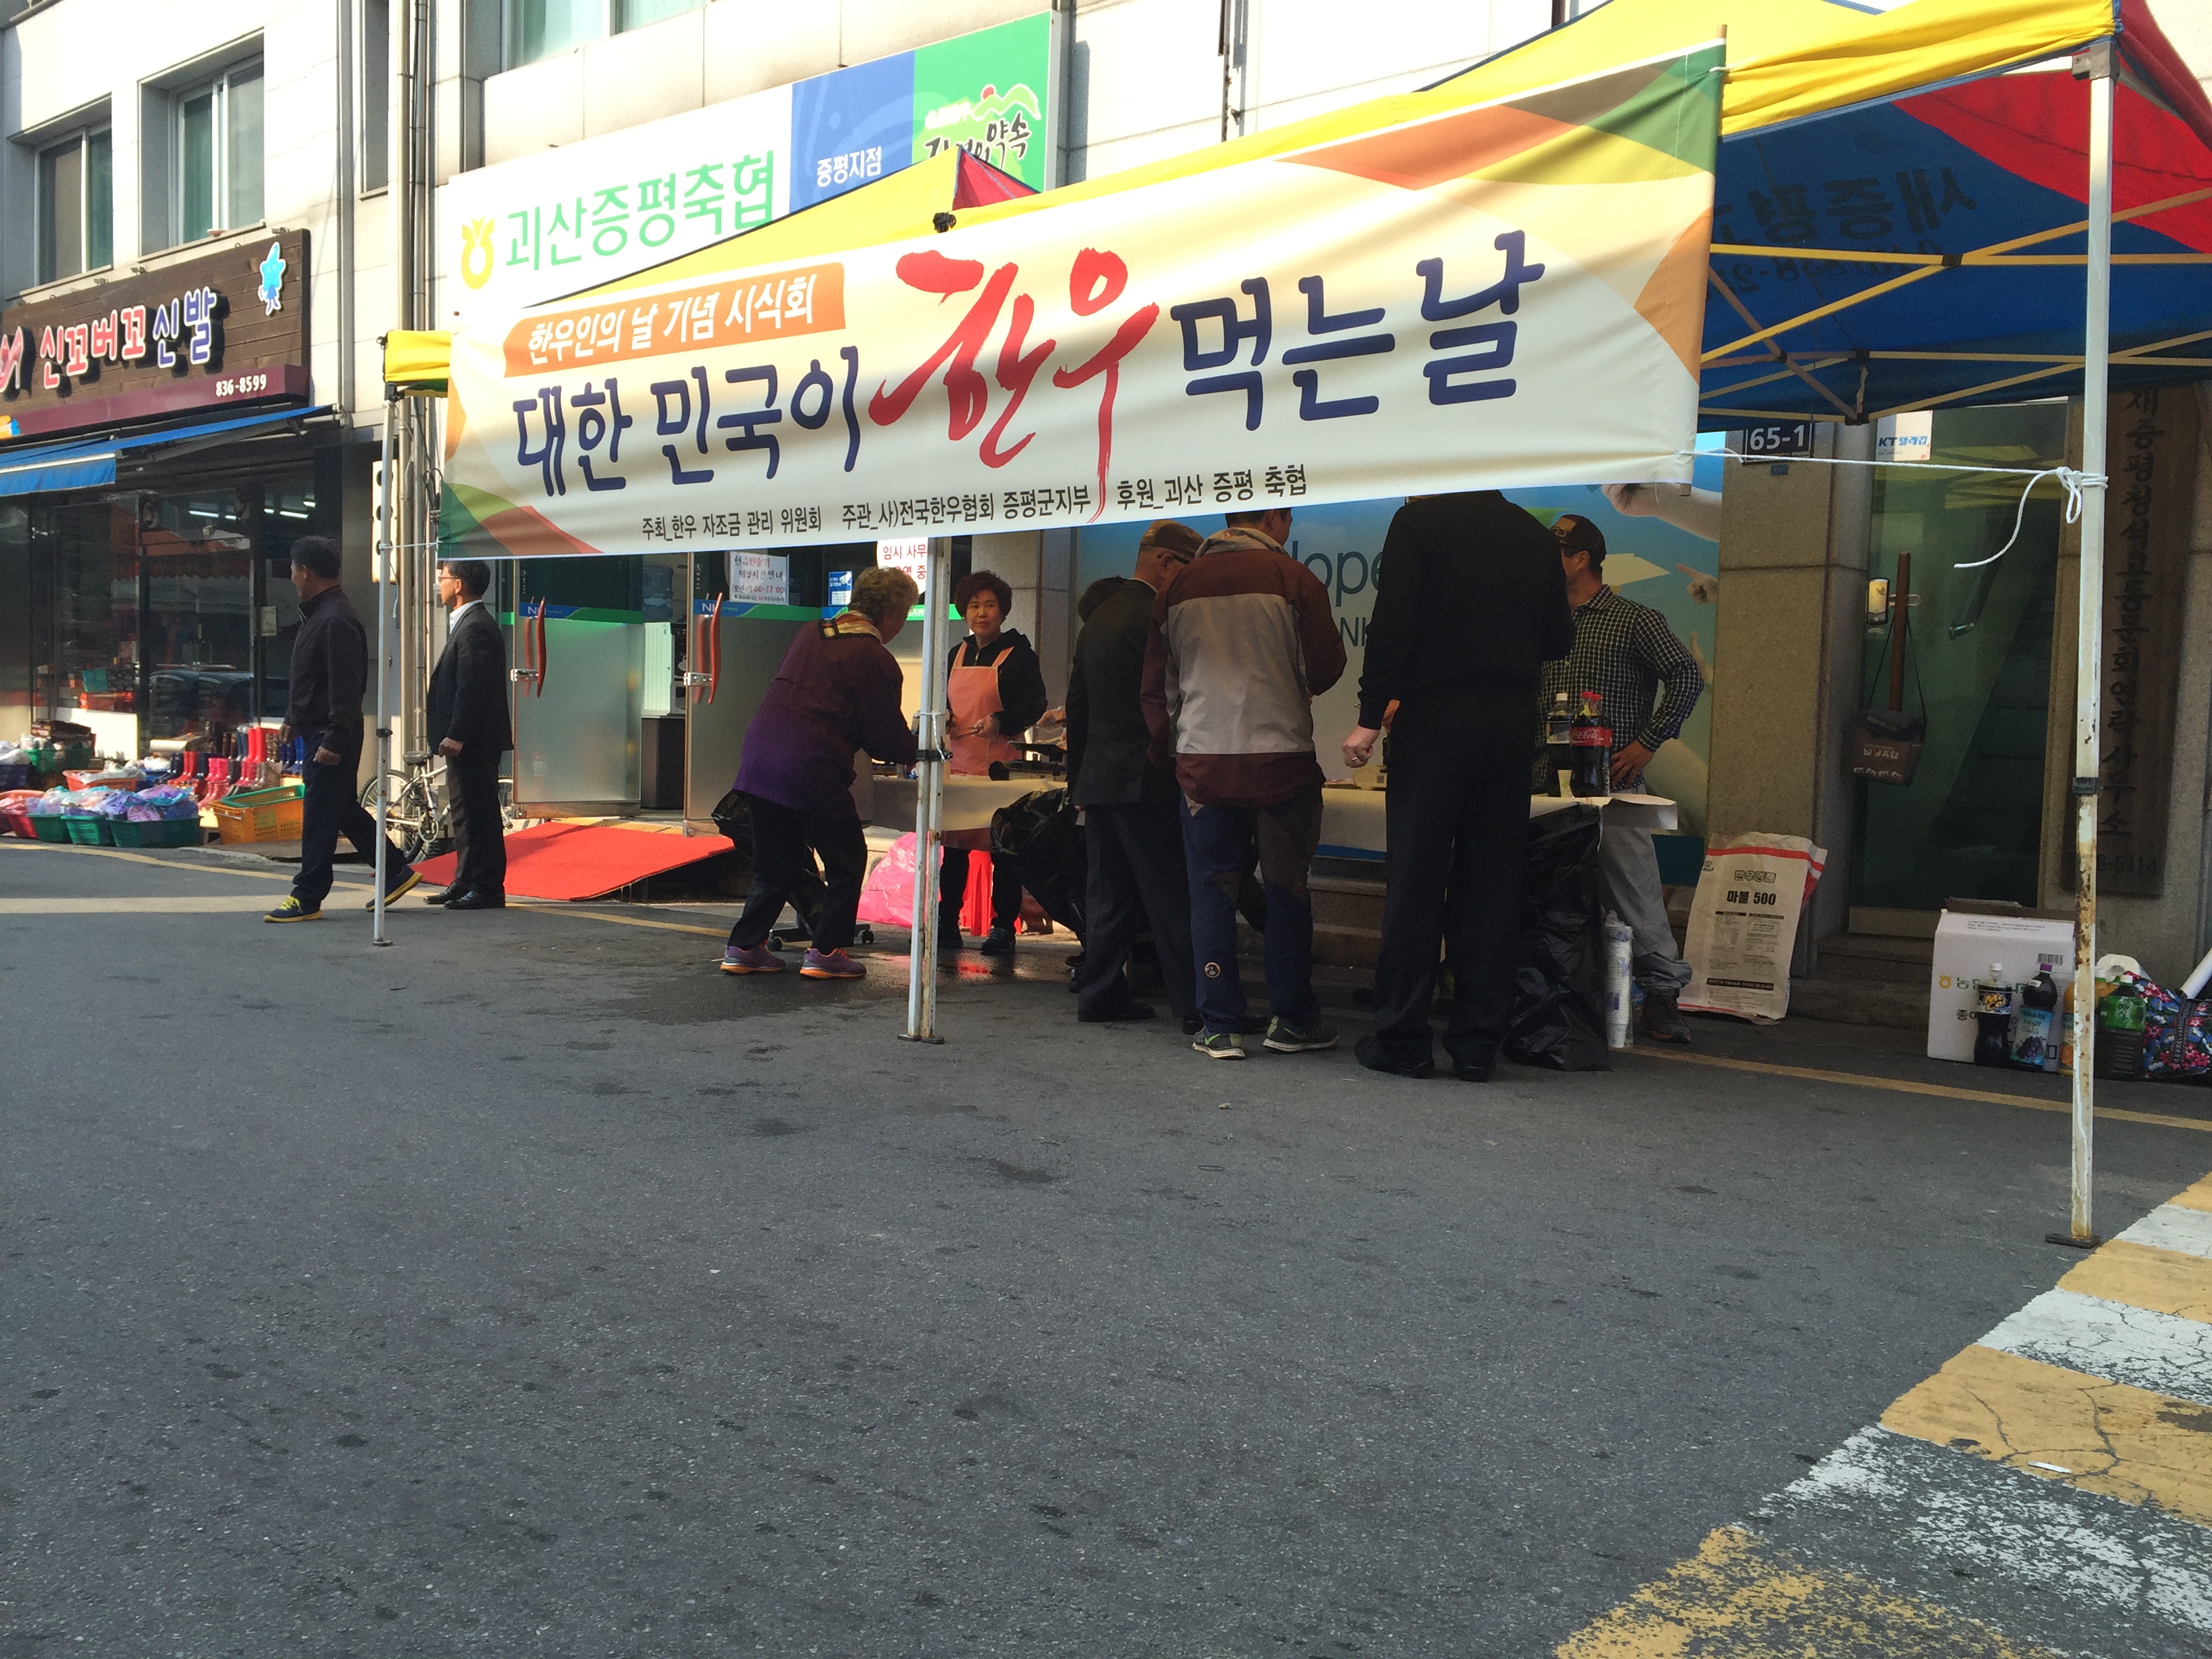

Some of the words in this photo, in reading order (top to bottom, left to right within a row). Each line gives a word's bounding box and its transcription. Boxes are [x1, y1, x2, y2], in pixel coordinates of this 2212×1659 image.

[817, 146, 882, 188] 증평지점
[506, 150, 774, 272] 괴산증평축협
[529, 308, 625, 364] 한우인의
[632, 304, 657, 350] 날
[663, 292, 718, 343] 기념
[725, 274, 817, 333] 시식회
[39, 304, 146, 390] 신꼬버꼬
[152, 286, 217, 369] 신발
[513, 377, 632, 497] 대한
[650, 346, 861, 485] 민국이
[1170, 275, 1396, 432] 먹는
[1416, 229, 1546, 406] 날
[216, 373, 267, 396] 836-8599
[1750, 424, 1805, 451] 65-1
[1879, 436, 1898, 447] KT
[1213, 468, 1254, 502] 증평
[1265, 464, 1307, 496] 축협
[1003, 485, 1090, 519] 증평군지부
[703, 512, 740, 538] 자조금
[747, 508, 773, 535] 관리
[781, 506, 821, 533] 위원회
[883, 545, 902, 560] 임시
[916, 565, 927, 579] 중
[1727, 890, 1750, 903] 마블
[1753, 892, 1777, 905] 500
